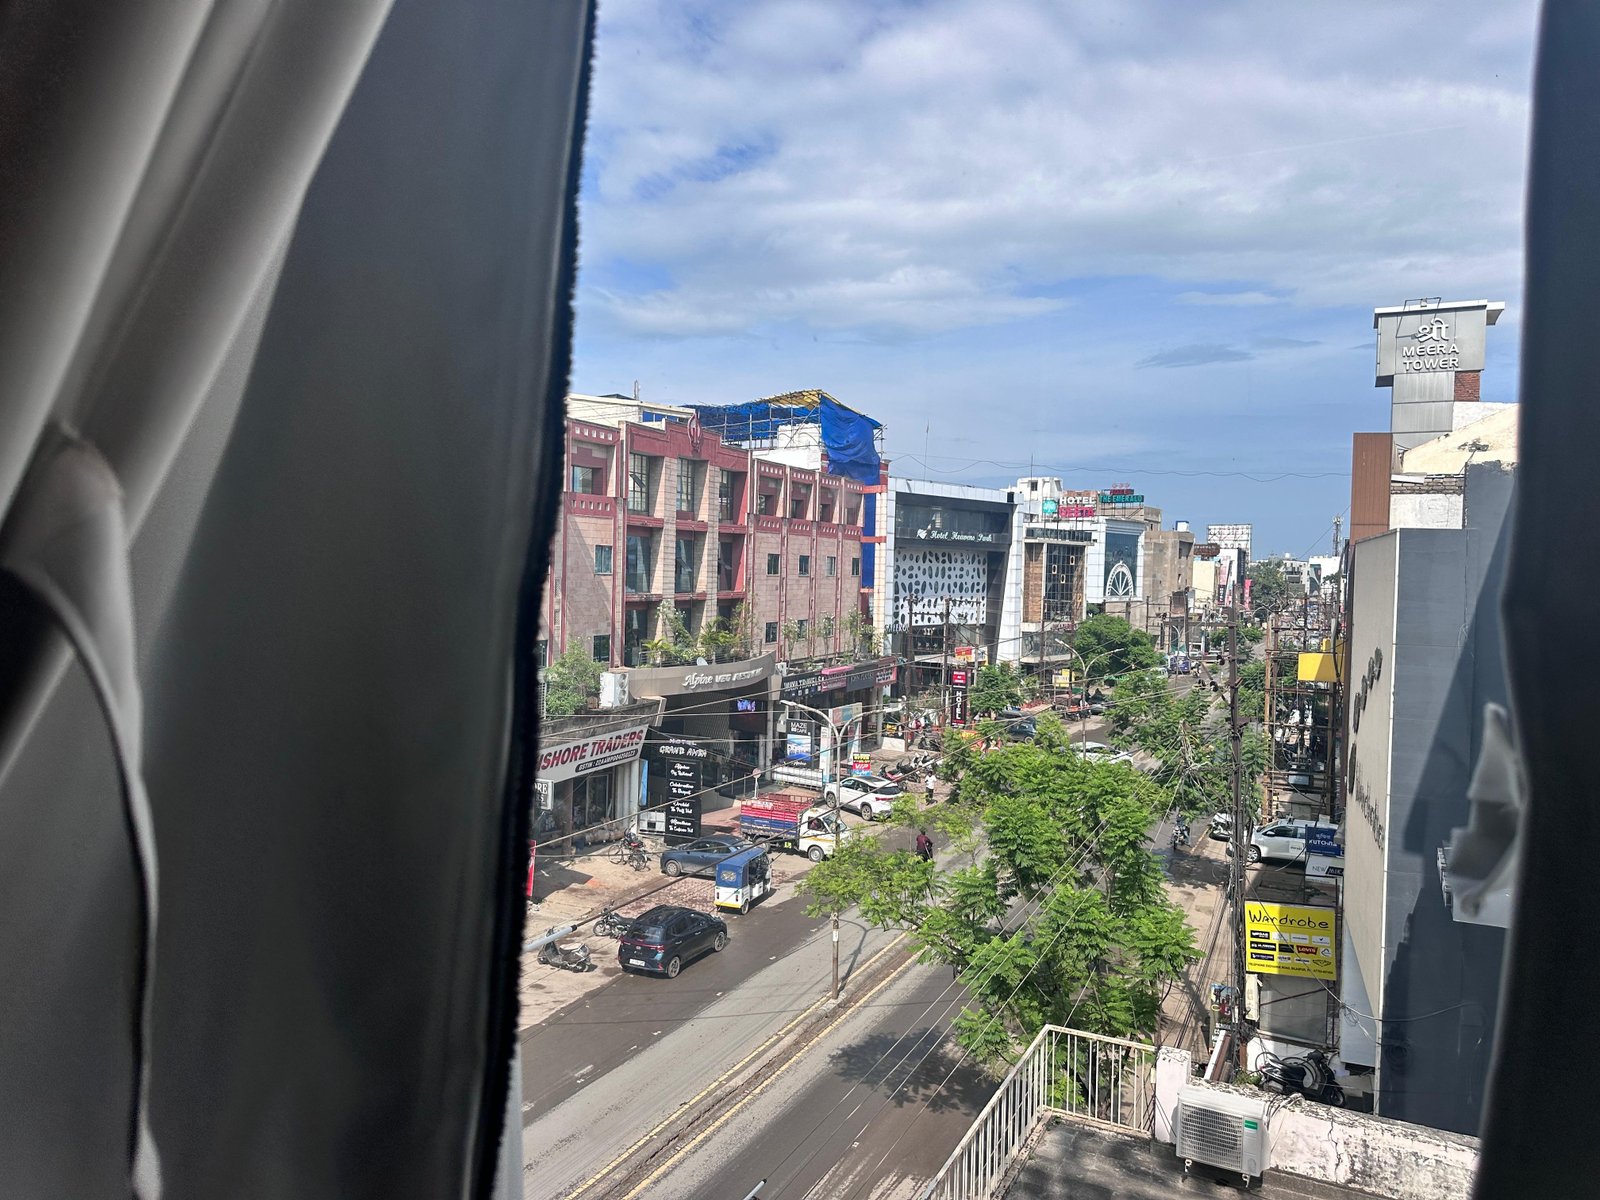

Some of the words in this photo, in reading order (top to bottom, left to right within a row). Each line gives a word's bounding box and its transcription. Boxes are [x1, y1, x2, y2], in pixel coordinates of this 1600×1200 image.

[1415, 317, 1450, 342] श्री
[1402, 344, 1460, 357] MEERA
[1403, 358, 1460, 371] TOWER
[1059, 496, 1096, 505] HOTEL
[1100, 495, 1111, 503] THE
[1112, 494, 1143, 503] EMERALD
[930, 530, 949, 540] Hotel
[977, 533, 993, 542] Park
[682, 672, 713, 689] Alpine
[590, 729, 645, 757] TRADERS
[1248, 909, 1330, 929] Wardrobe
